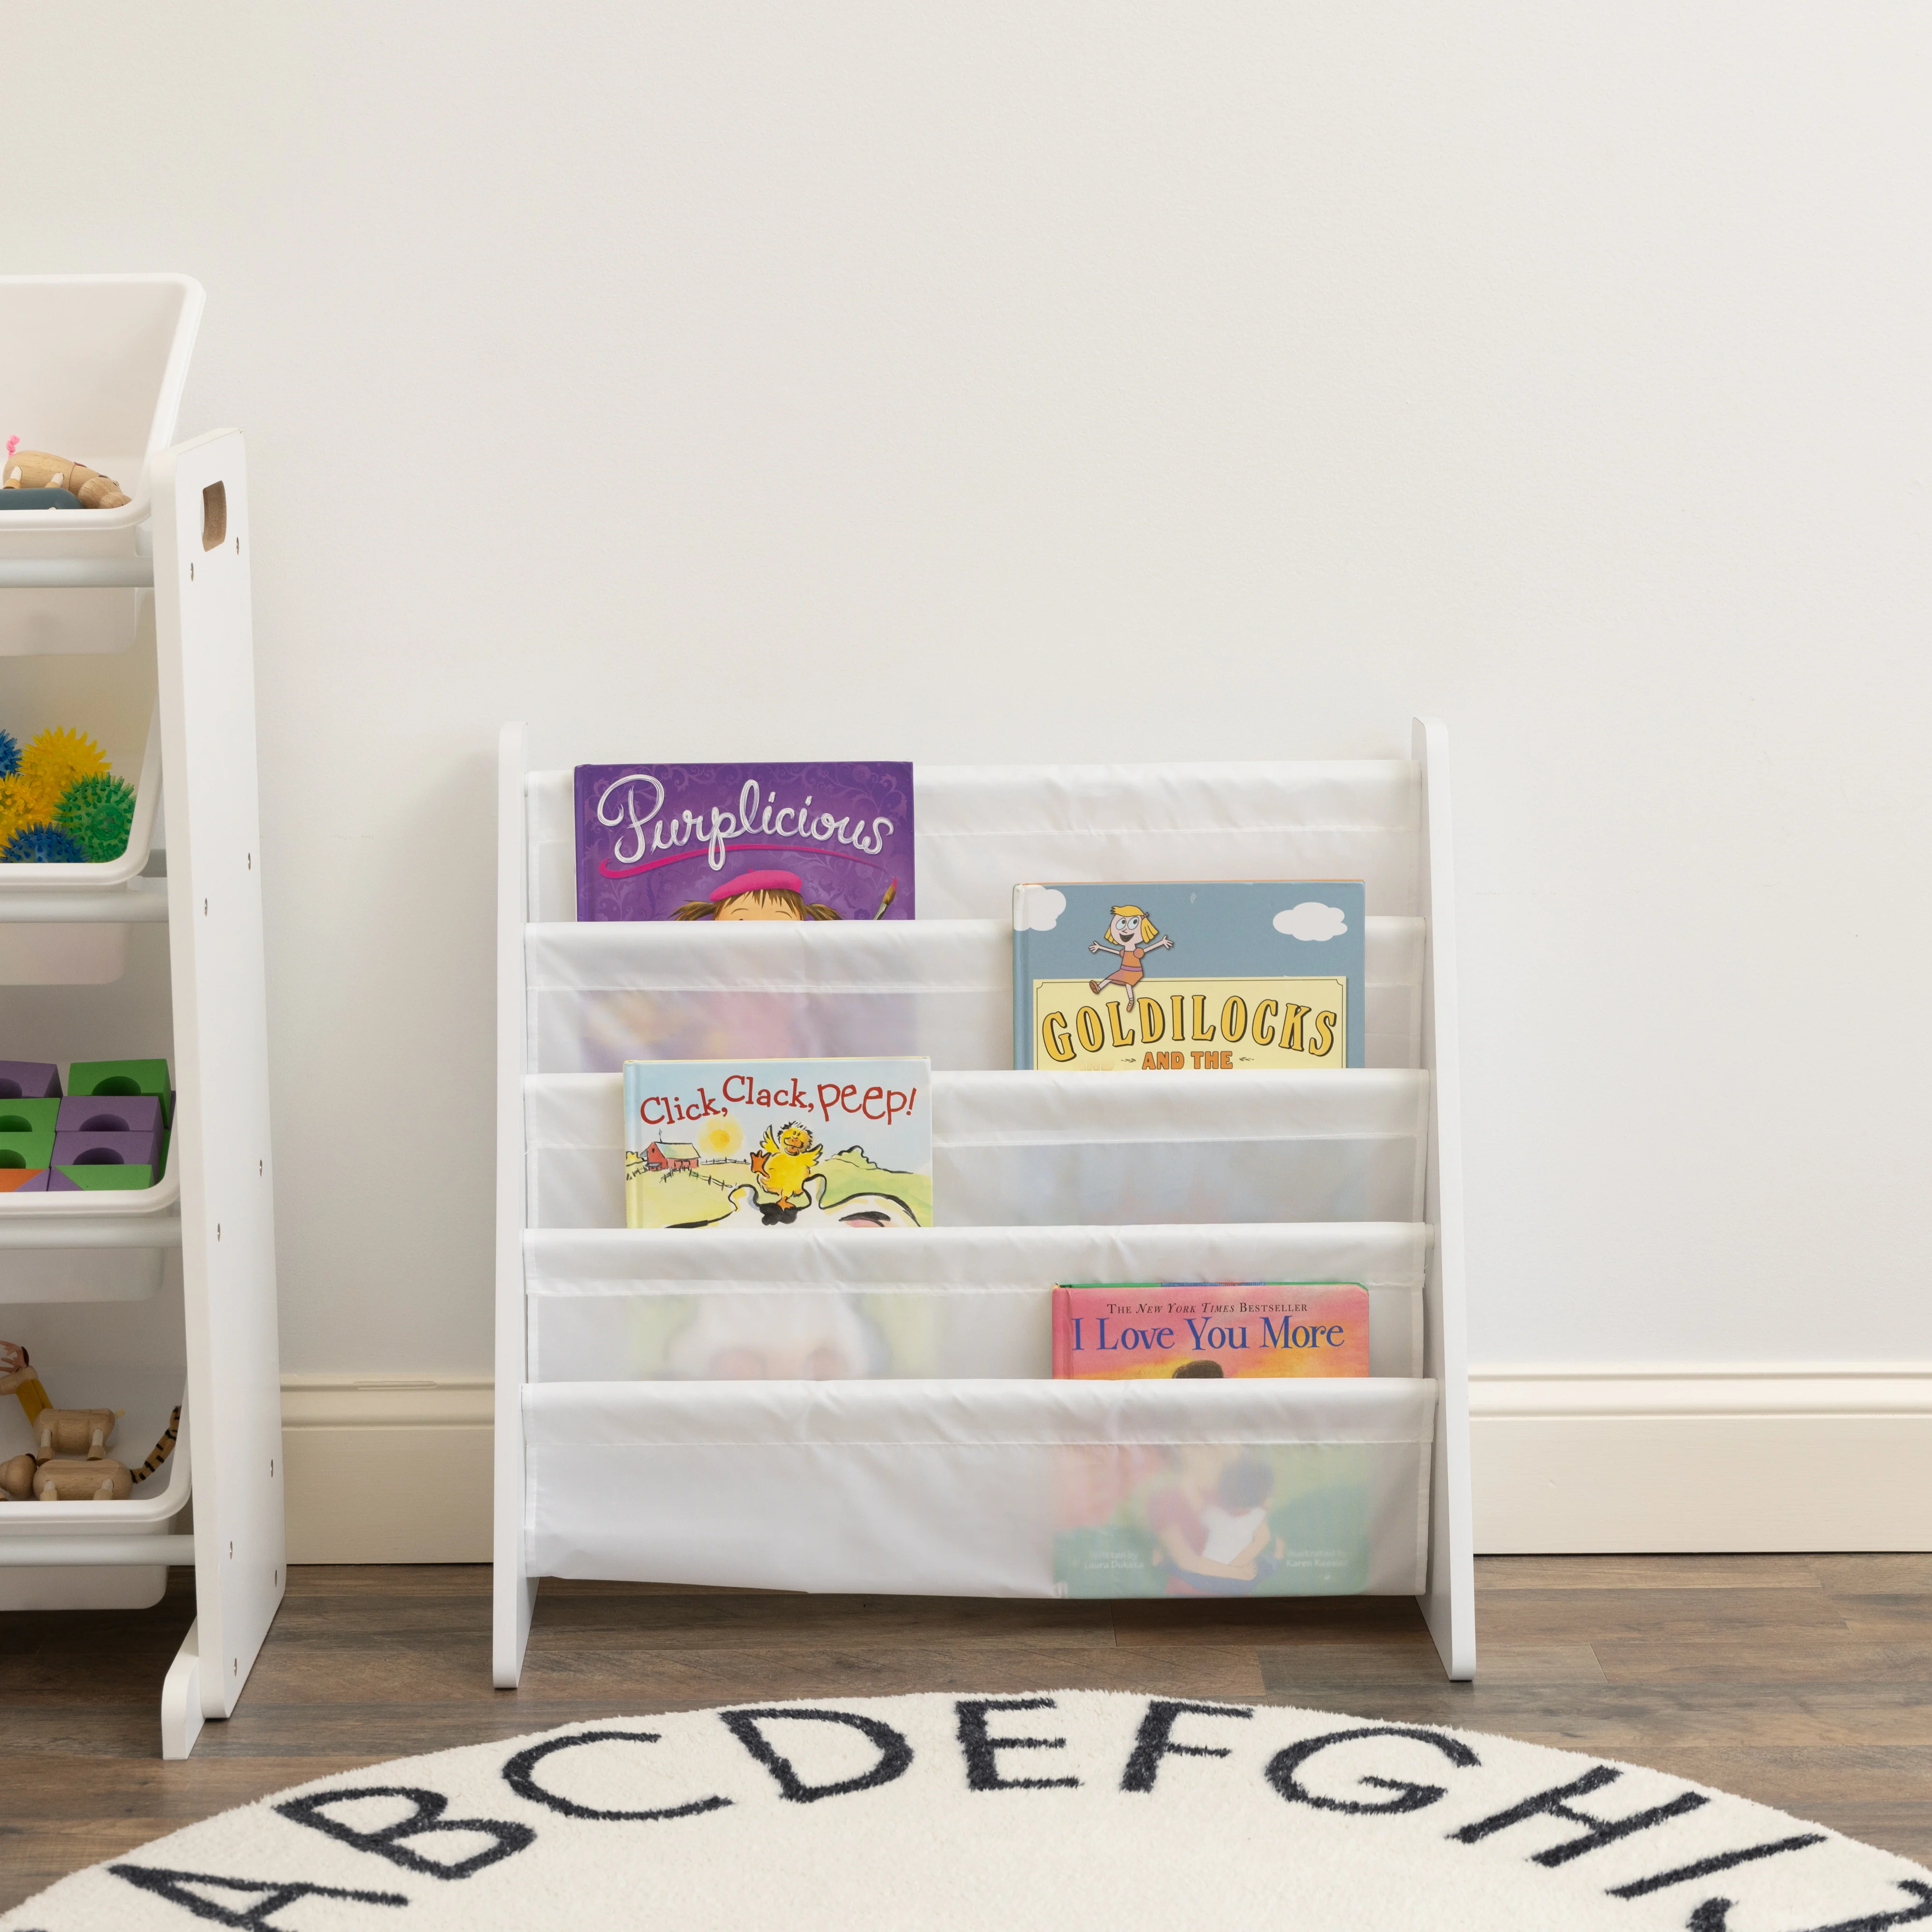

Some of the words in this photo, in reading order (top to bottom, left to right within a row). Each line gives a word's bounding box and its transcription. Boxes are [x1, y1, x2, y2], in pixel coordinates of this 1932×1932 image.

[597, 774, 894, 871] Purplicious
[1041, 994, 1338, 1063] GOLDILOCKS
[1142, 1051, 1185, 1070] AND
[1191, 1051, 1233, 1070] THE
[640, 1088, 728, 1125] Click,
[723, 1075, 814, 1113] Clack,
[1071, 1317, 1085, 1350] I
[1096, 1317, 1175, 1350] Love
[1183, 1316, 1250, 1351] You
[1259, 1315, 1345, 1349] More
